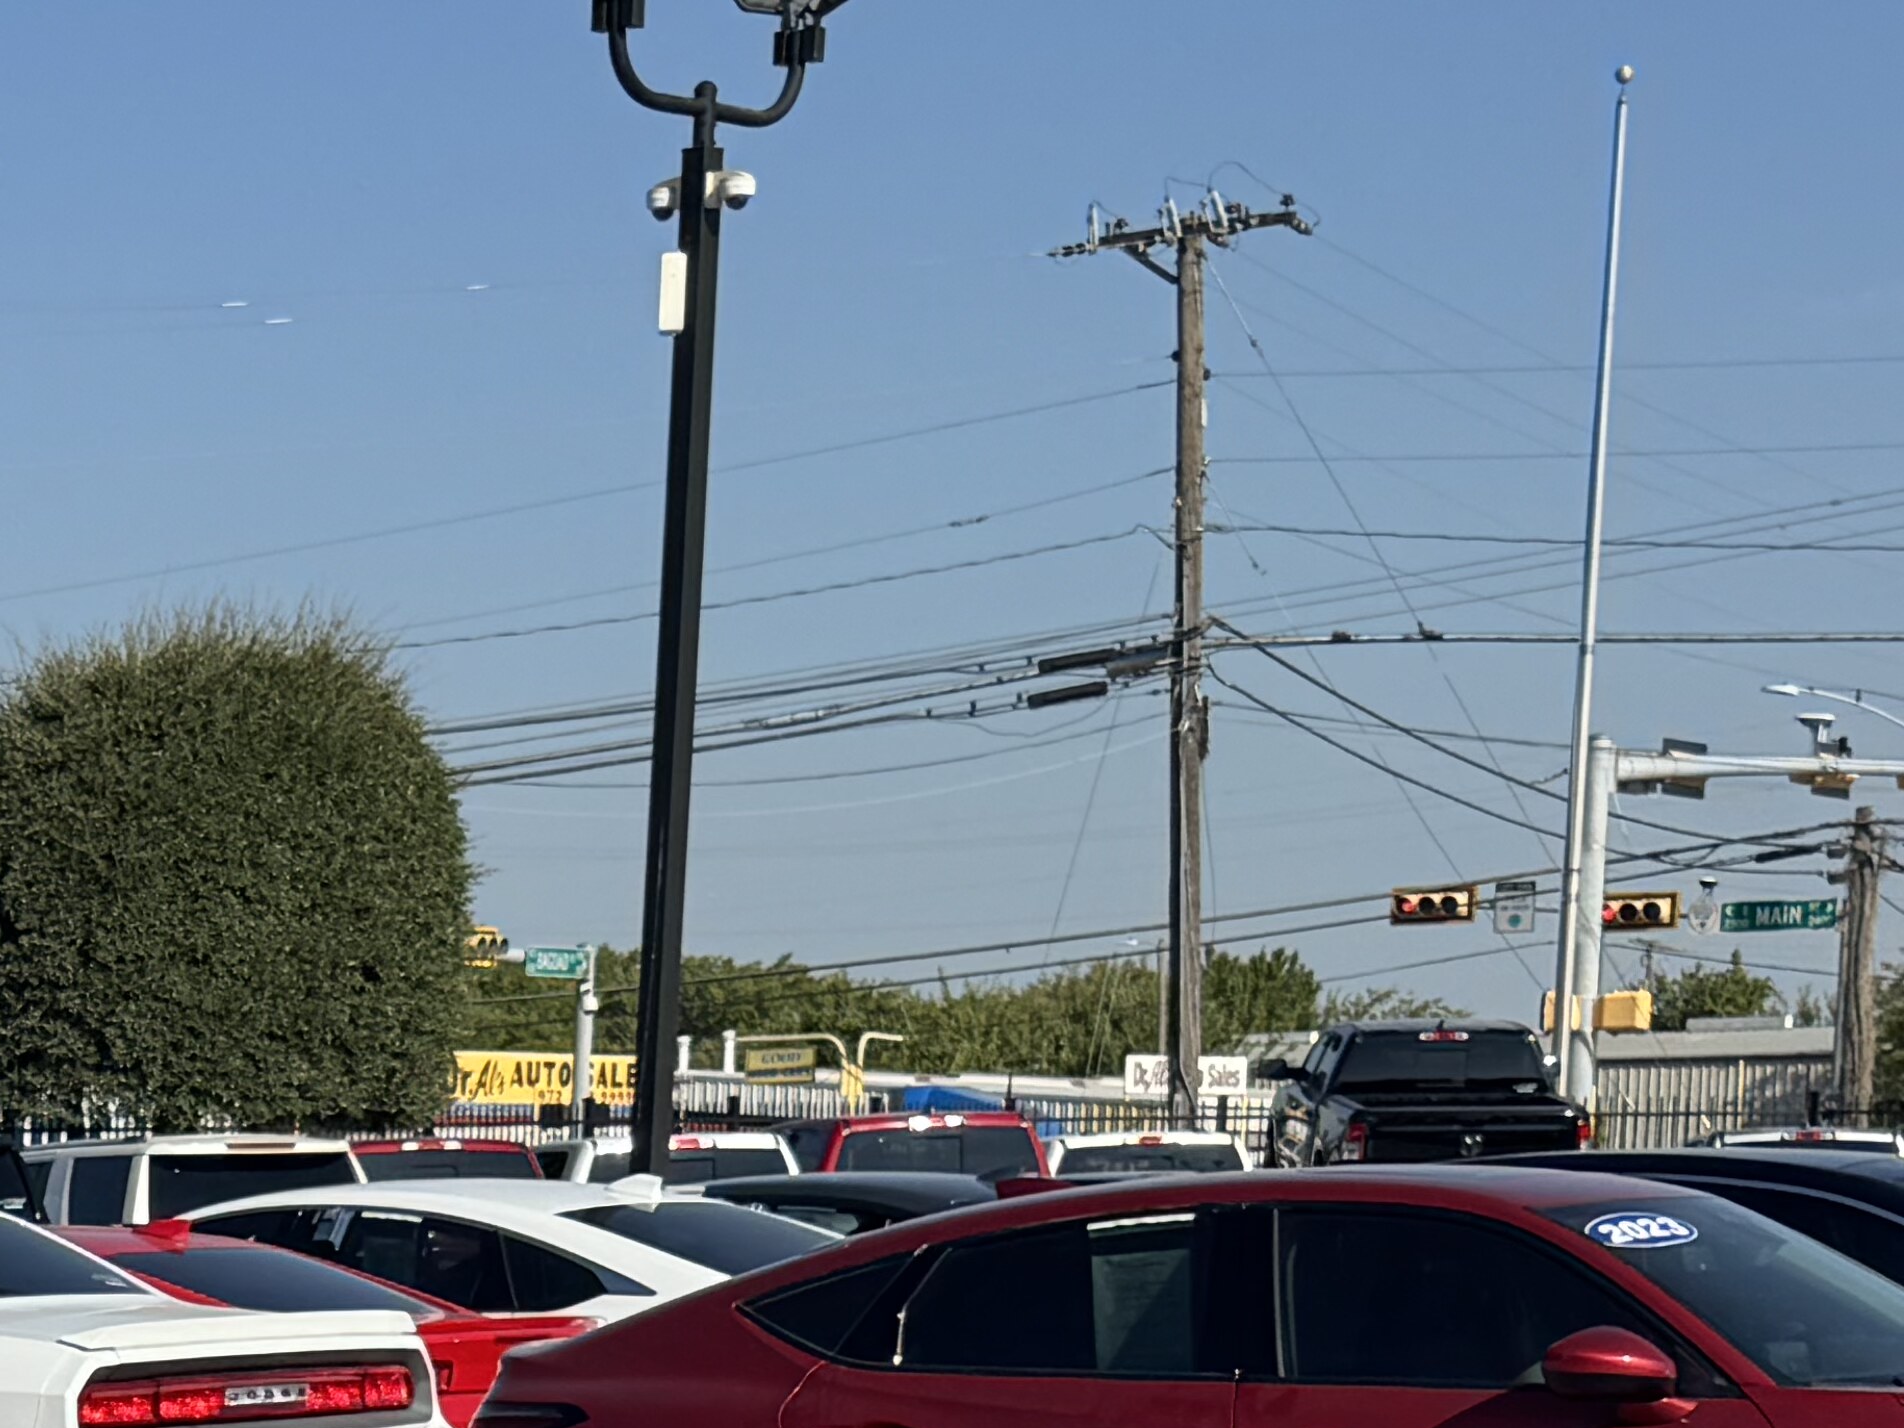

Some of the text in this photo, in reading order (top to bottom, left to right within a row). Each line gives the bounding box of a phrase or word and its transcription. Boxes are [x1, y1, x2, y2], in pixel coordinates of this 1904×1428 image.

[1755, 904, 1803, 927] MAIN
[509, 1060, 571, 1089] AUTO
[1598, 1217, 1690, 1244] 2023
